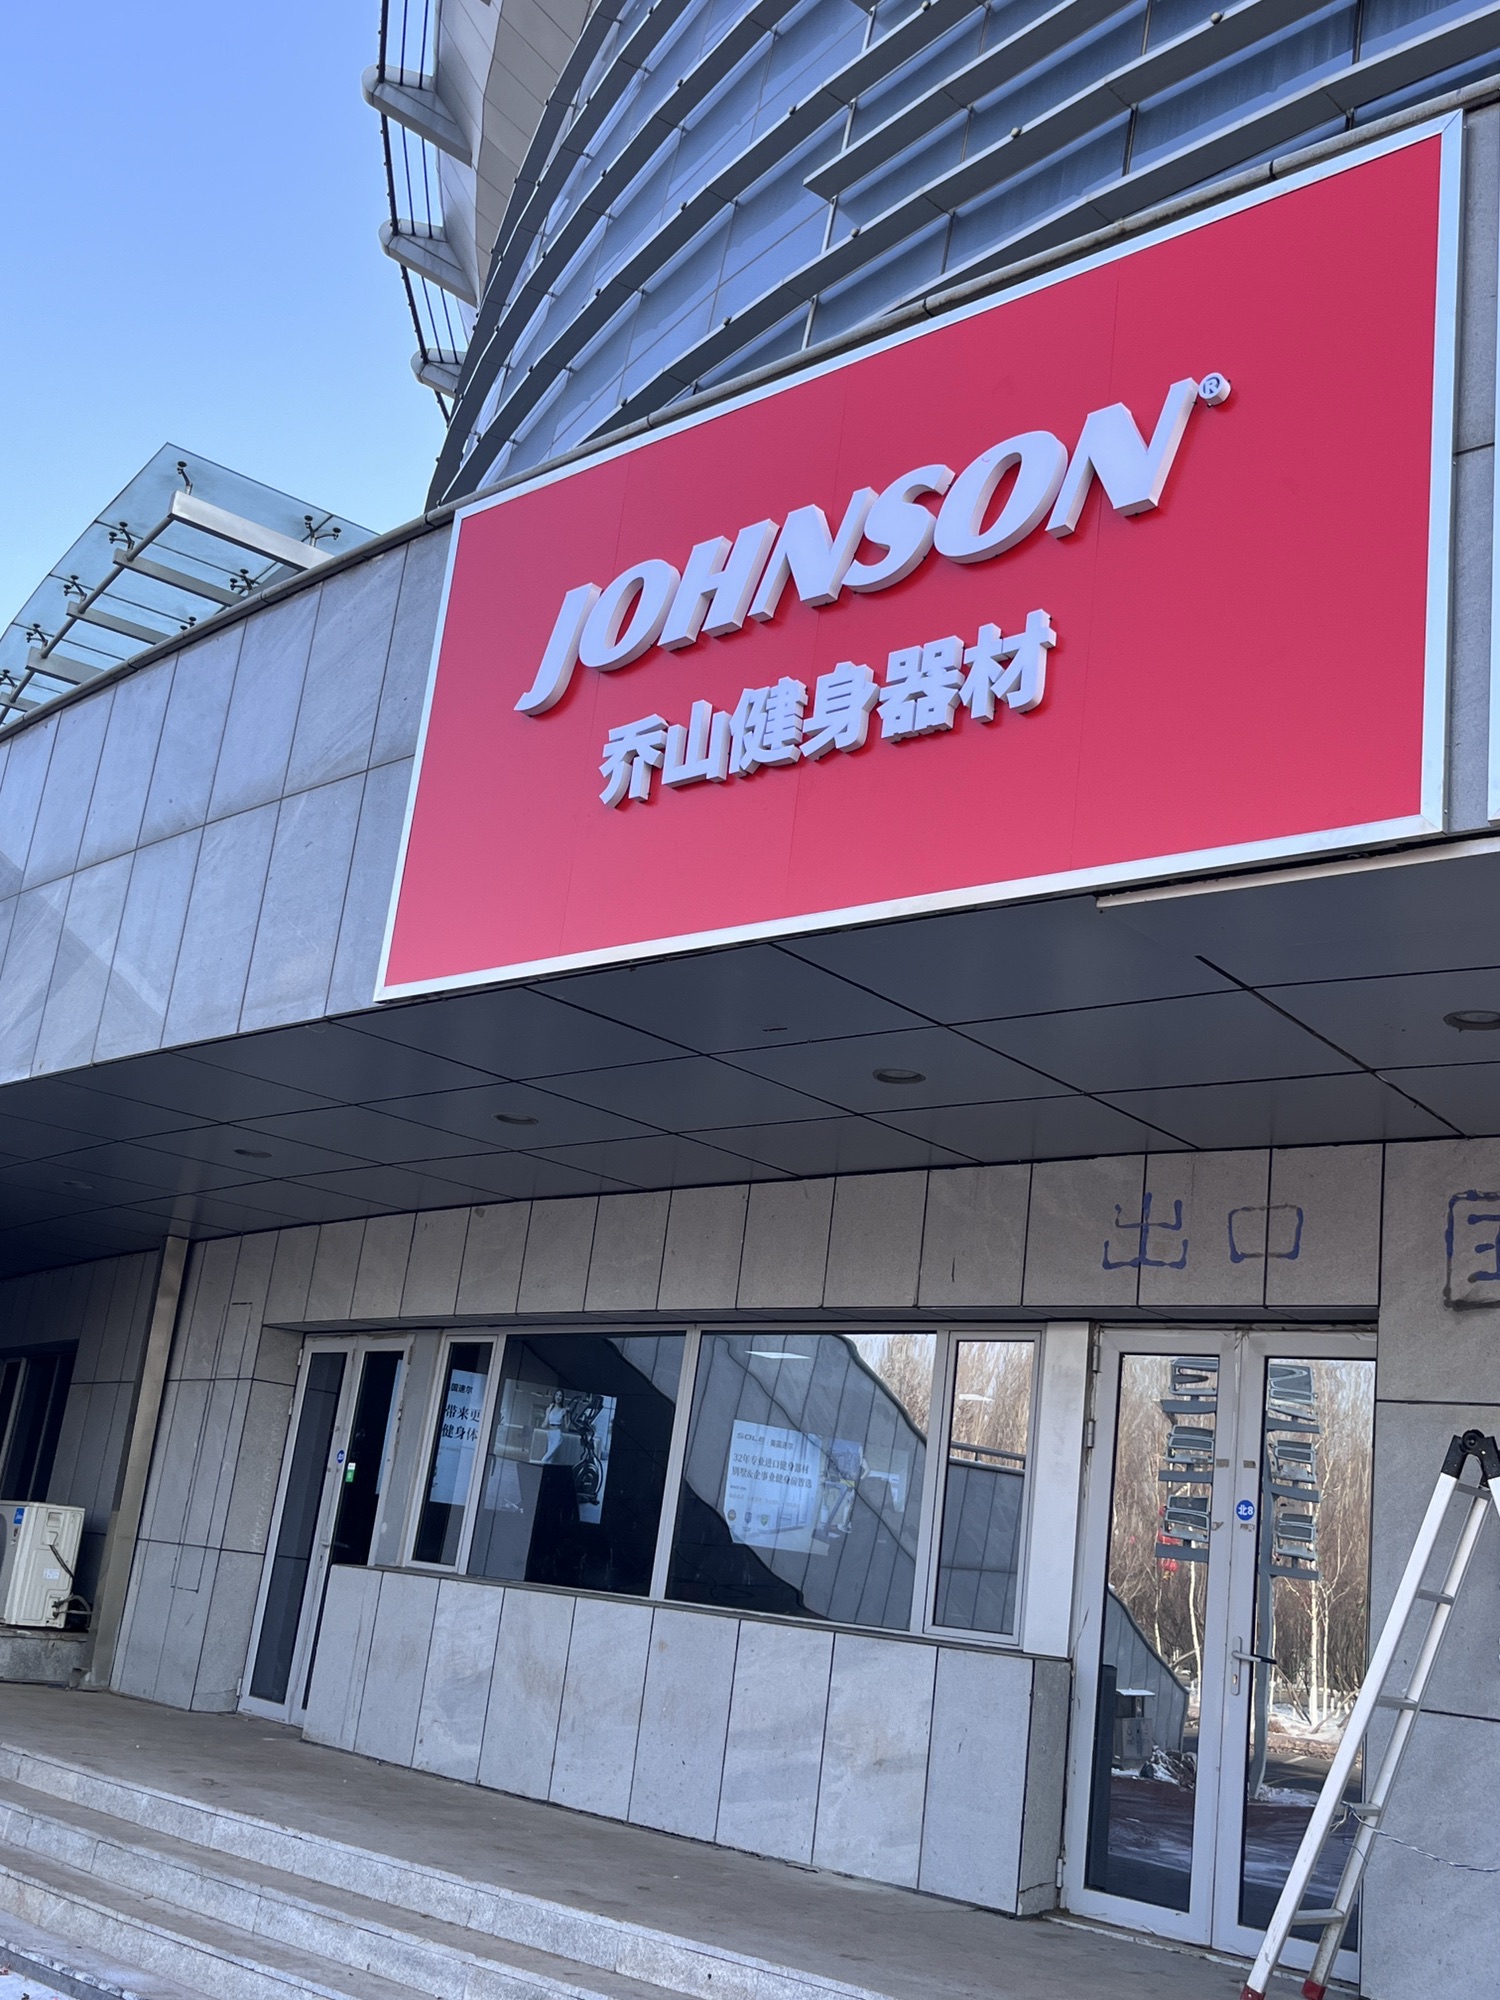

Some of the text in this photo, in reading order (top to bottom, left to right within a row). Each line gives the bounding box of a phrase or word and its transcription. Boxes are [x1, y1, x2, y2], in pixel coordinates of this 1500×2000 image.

[598, 608, 1058, 811] 乔山健身器材
[1237, 1504, 1254, 1516] 北8
